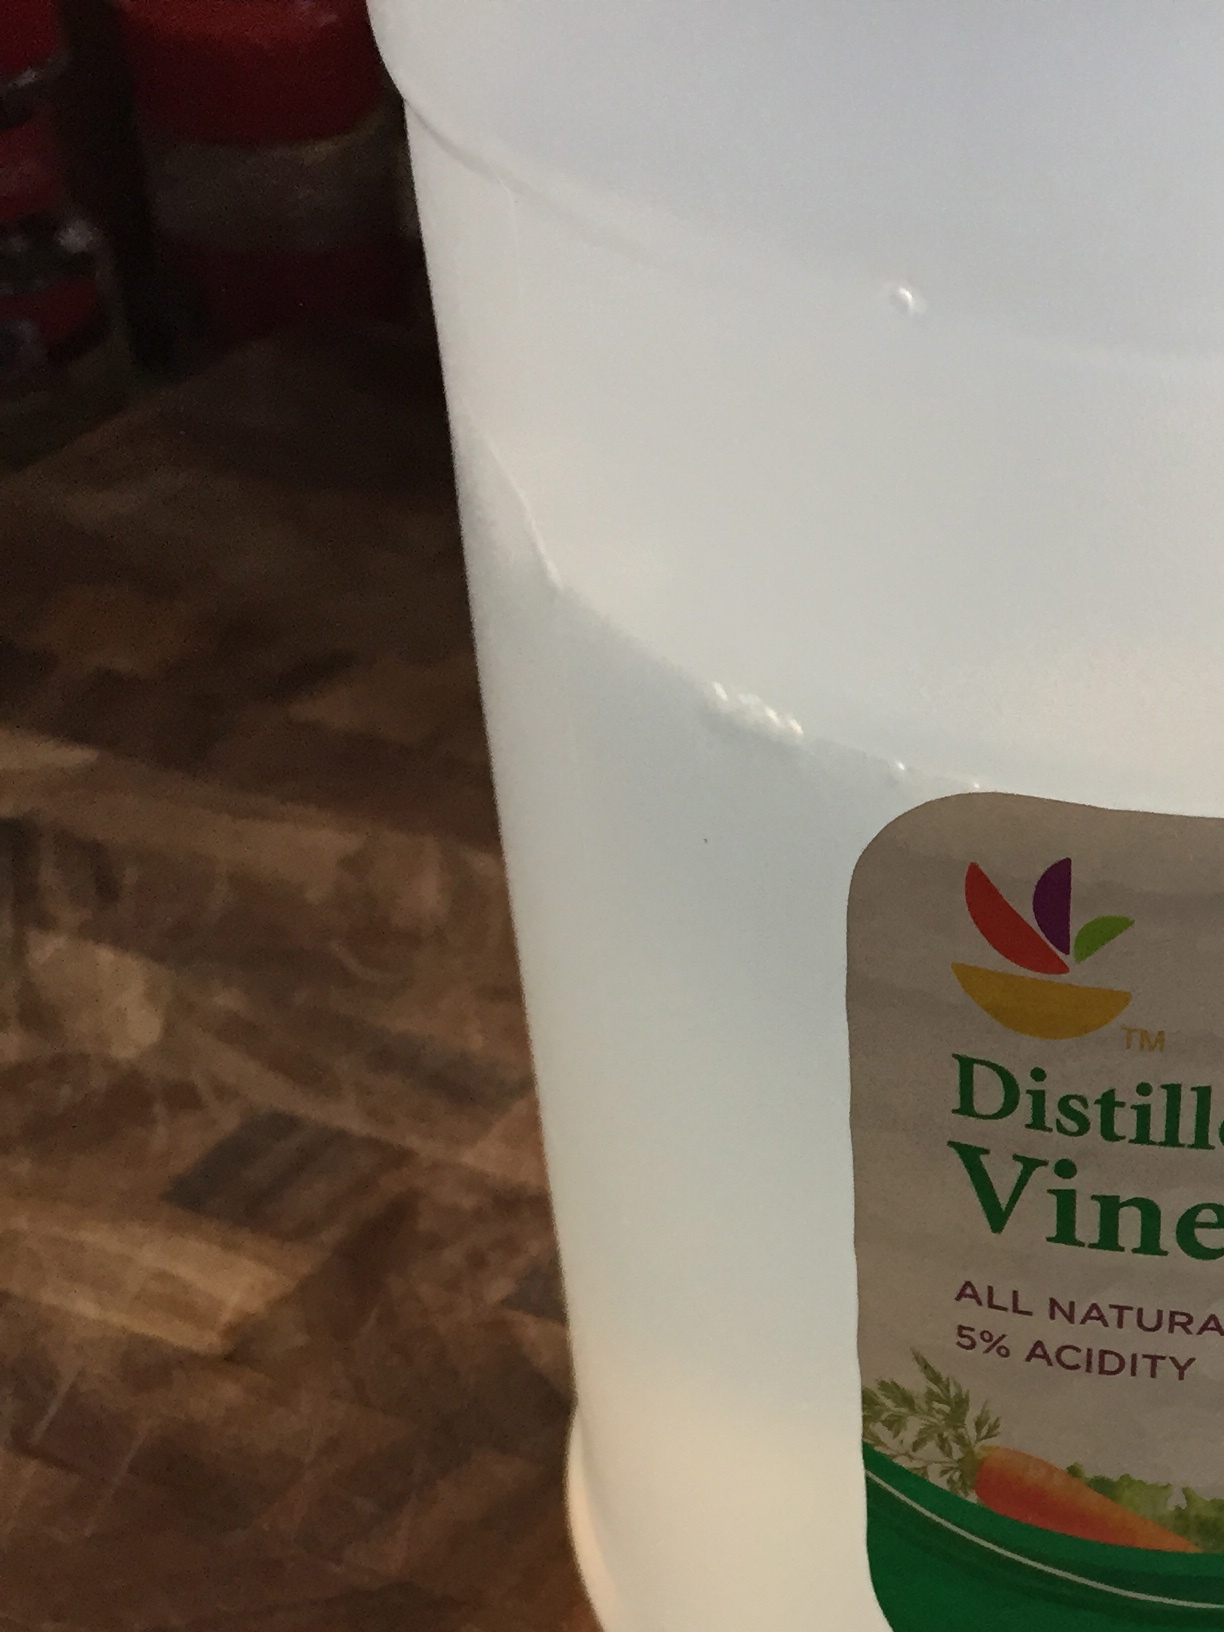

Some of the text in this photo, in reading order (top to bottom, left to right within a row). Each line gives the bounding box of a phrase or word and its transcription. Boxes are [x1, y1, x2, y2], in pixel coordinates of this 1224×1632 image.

[1120, 1026, 1166, 1052] TM
[955, 1280, 1033, 1316] ALL
[955, 1325, 1197, 1381] 5% ACIDITY
